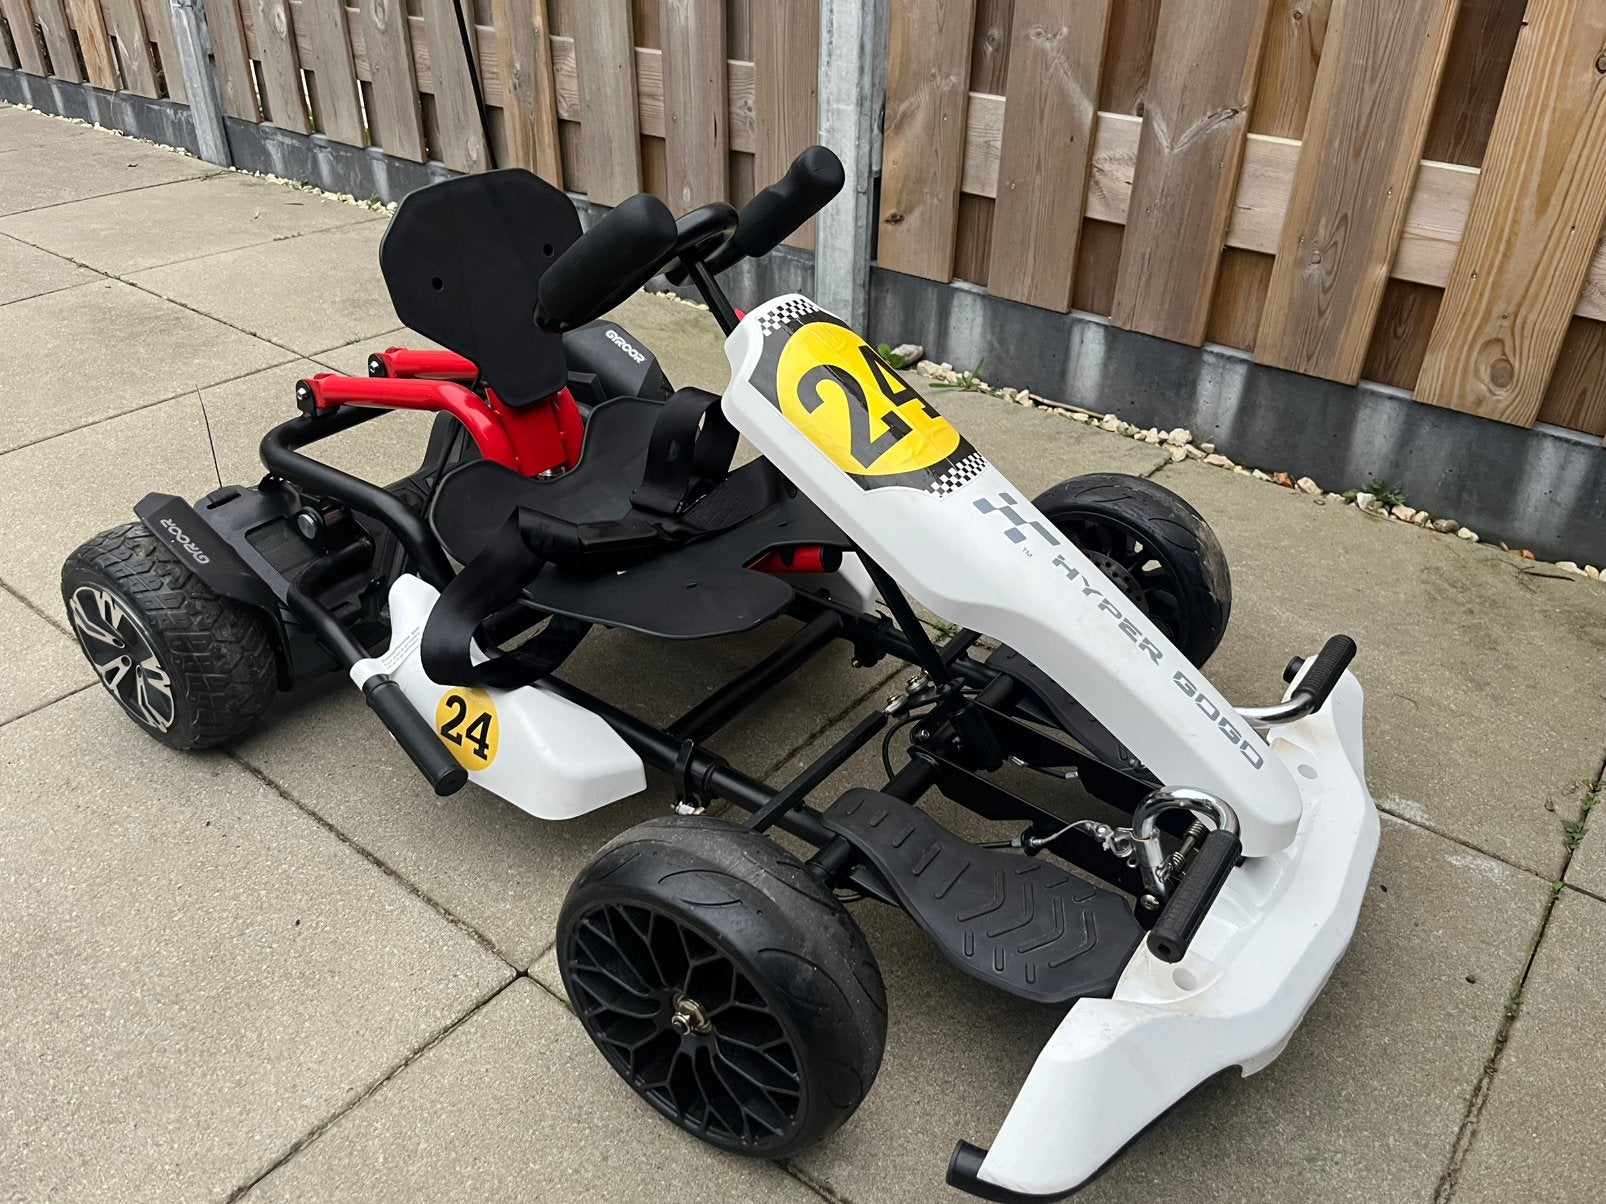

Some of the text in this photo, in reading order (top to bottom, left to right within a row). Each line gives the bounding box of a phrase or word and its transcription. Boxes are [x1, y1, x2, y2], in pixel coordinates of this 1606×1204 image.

[605, 329, 645, 364] GYROOR
[796, 345, 942, 469] 24
[160, 518, 210, 564] GYROOR
[1052, 554, 1264, 770] HYPER GOGO
[440, 694, 493, 761] 24
